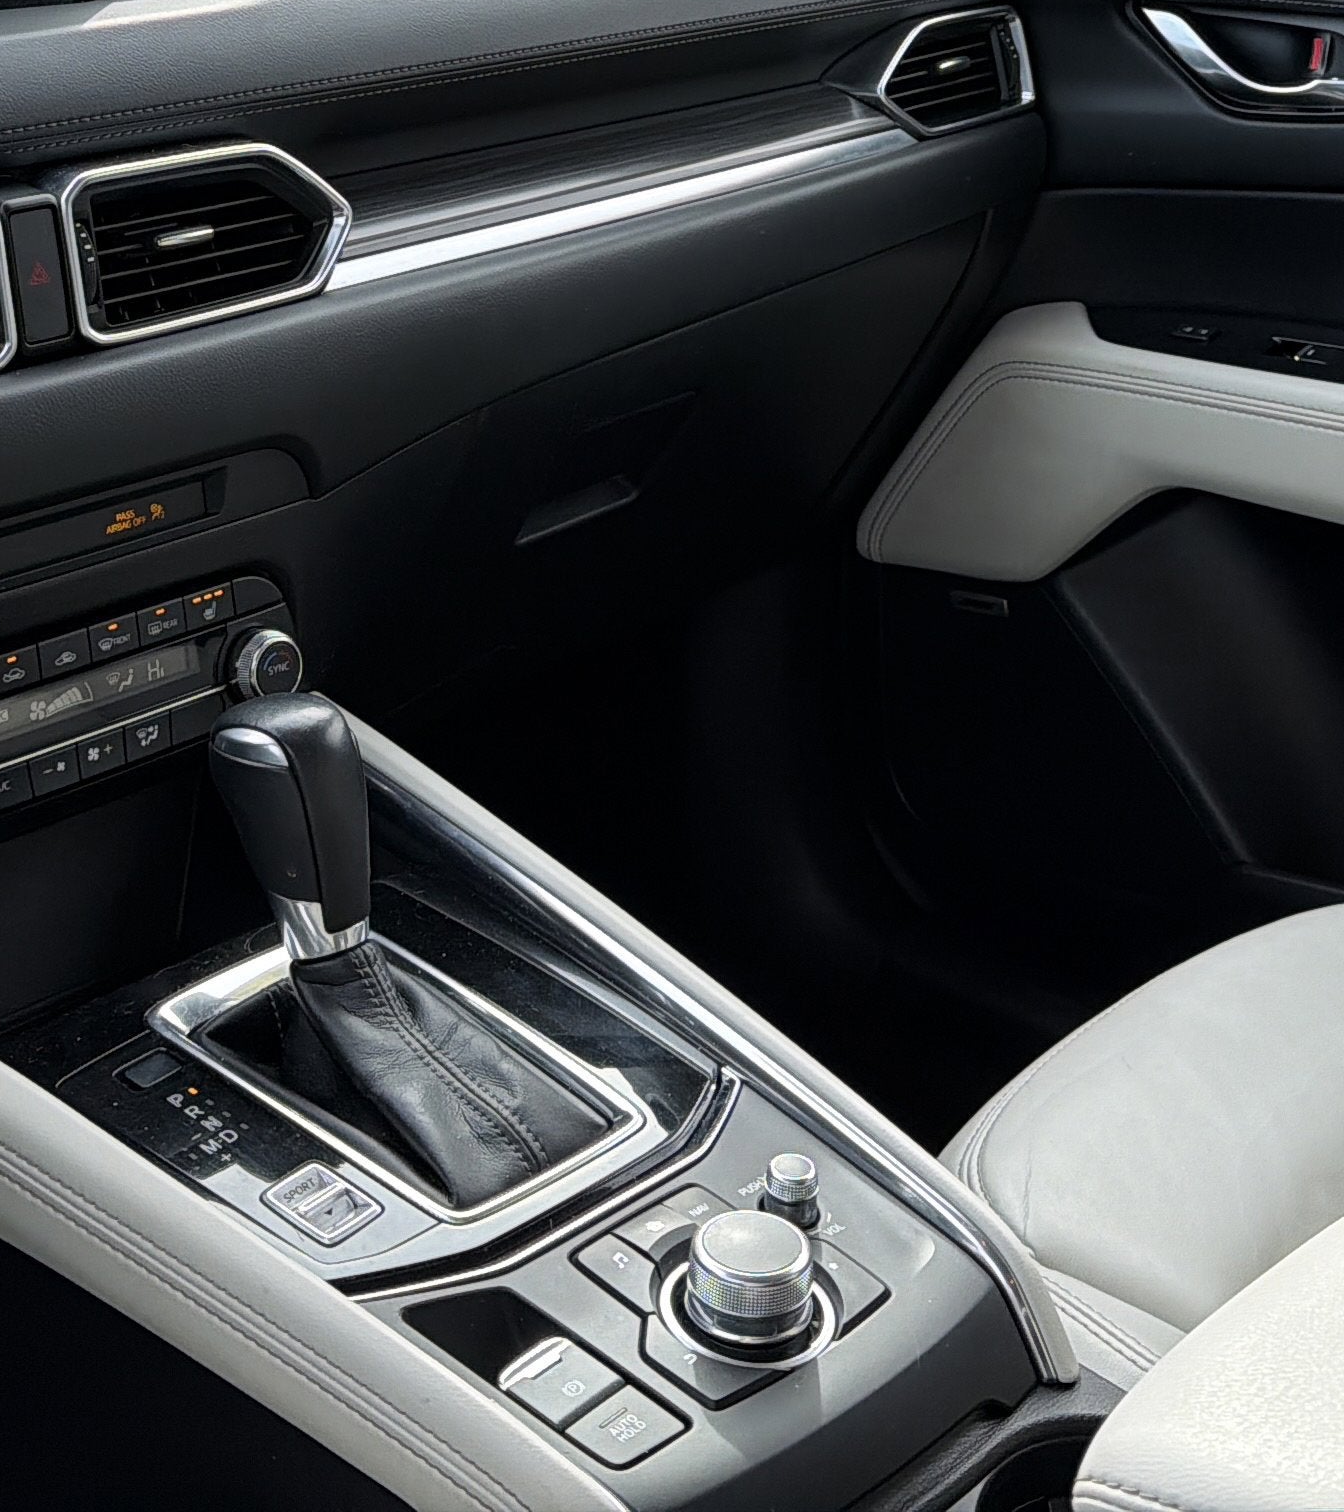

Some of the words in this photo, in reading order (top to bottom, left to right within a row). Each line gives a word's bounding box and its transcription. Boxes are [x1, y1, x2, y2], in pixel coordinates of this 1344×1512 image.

[115, 509, 136, 522] PASS
[106, 520, 132, 535] AIRBAG
[133, 515, 146, 527] OFF
[162, 618, 178, 630] REAR
[113, 633, 131, 645] FRONT
[267, 660, 291, 676] SYNC
[166, 1093, 184, 1108] P
[184, 1105, 205, 1119] R
[200, 1115, 223, 1131] N
[199, 1138, 222, 1155] M
[218, 1129, 239, 1144] D
[283, 1177, 315, 1204] SPORT
[688, 1202, 710, 1217] NAV
[822, 1222, 847, 1236] VOL
[609, 1414, 637, 1437] AUTO
[617, 1420, 647, 1443] HOLD
